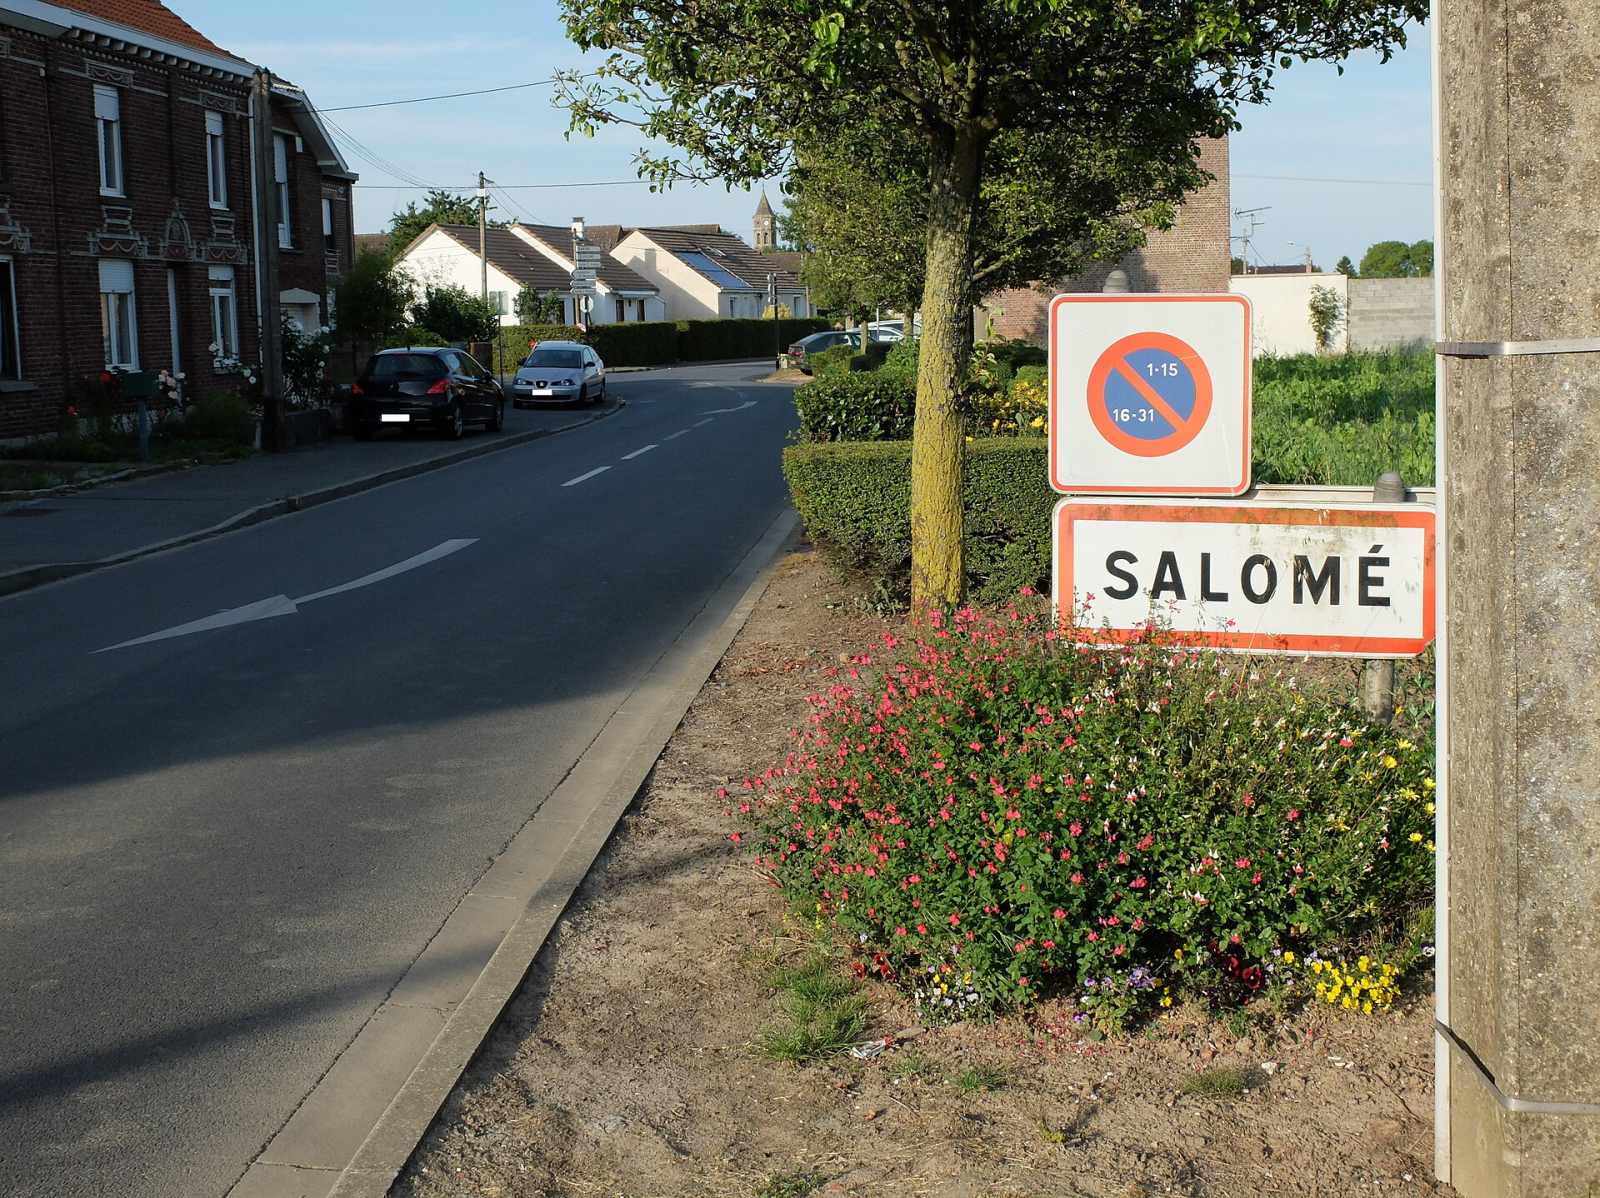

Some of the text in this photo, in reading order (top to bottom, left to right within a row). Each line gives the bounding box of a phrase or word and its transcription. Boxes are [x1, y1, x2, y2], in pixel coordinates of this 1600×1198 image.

[1146, 362, 1178, 377] 1-15
[1112, 408, 1154, 422] 16-31
[1103, 544, 1391, 607] SALOMÉ
